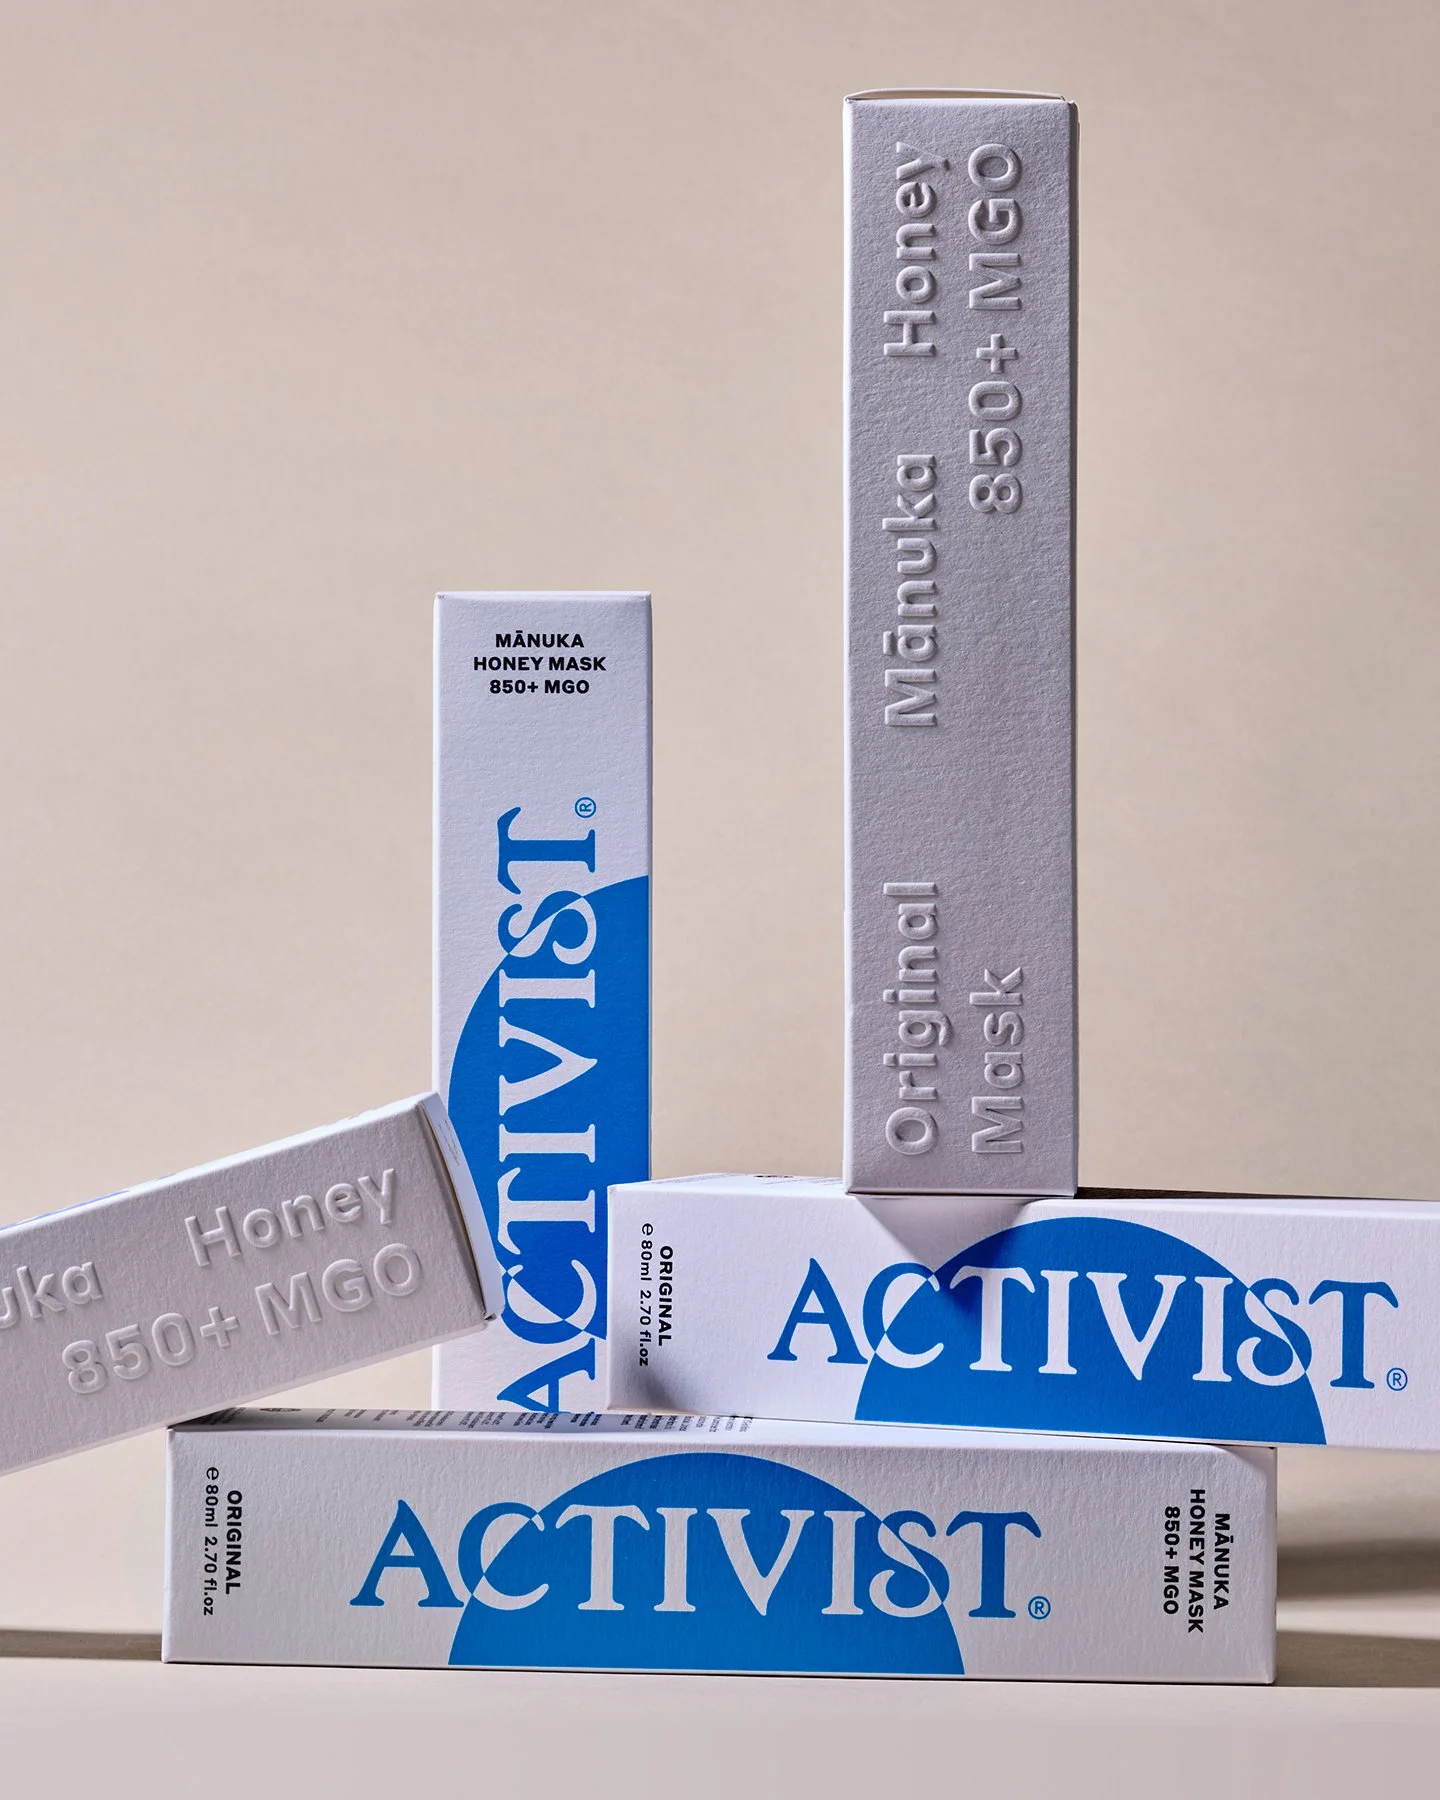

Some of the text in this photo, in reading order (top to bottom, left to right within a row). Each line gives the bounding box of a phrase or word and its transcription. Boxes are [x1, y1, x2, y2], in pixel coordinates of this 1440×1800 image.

[473, 656, 607, 671] HONEY MASK
[495, 630, 585, 648] MĀNUKA
[882, 141, 951, 1156] Original Mānuka Honey
[968, 142, 1024, 1155] Mask 850+ MGO
[489, 679, 590, 694] 850+ MGO
[184, 1168, 397, 1268] Honey
[640, 1239, 653, 1281] 80ml
[61, 1242, 425, 1395] 850+ MGO
[639, 1289, 652, 1326] 2.70
[658, 1245, 674, 1346] ORIGINAL
[639, 1329, 652, 1367] fl.oz
[205, 1484, 219, 1527] 80ml
[204, 1536, 218, 1574] 2.70
[225, 1490, 243, 1595] ORIGINAL
[1163, 1506, 1181, 1615] 850+ MGO
[1187, 1489, 1206, 1633] HONEY MASK
[1213, 1513, 1234, 1610] MĀNUKA
[203, 1577, 217, 1616] fl.oz
